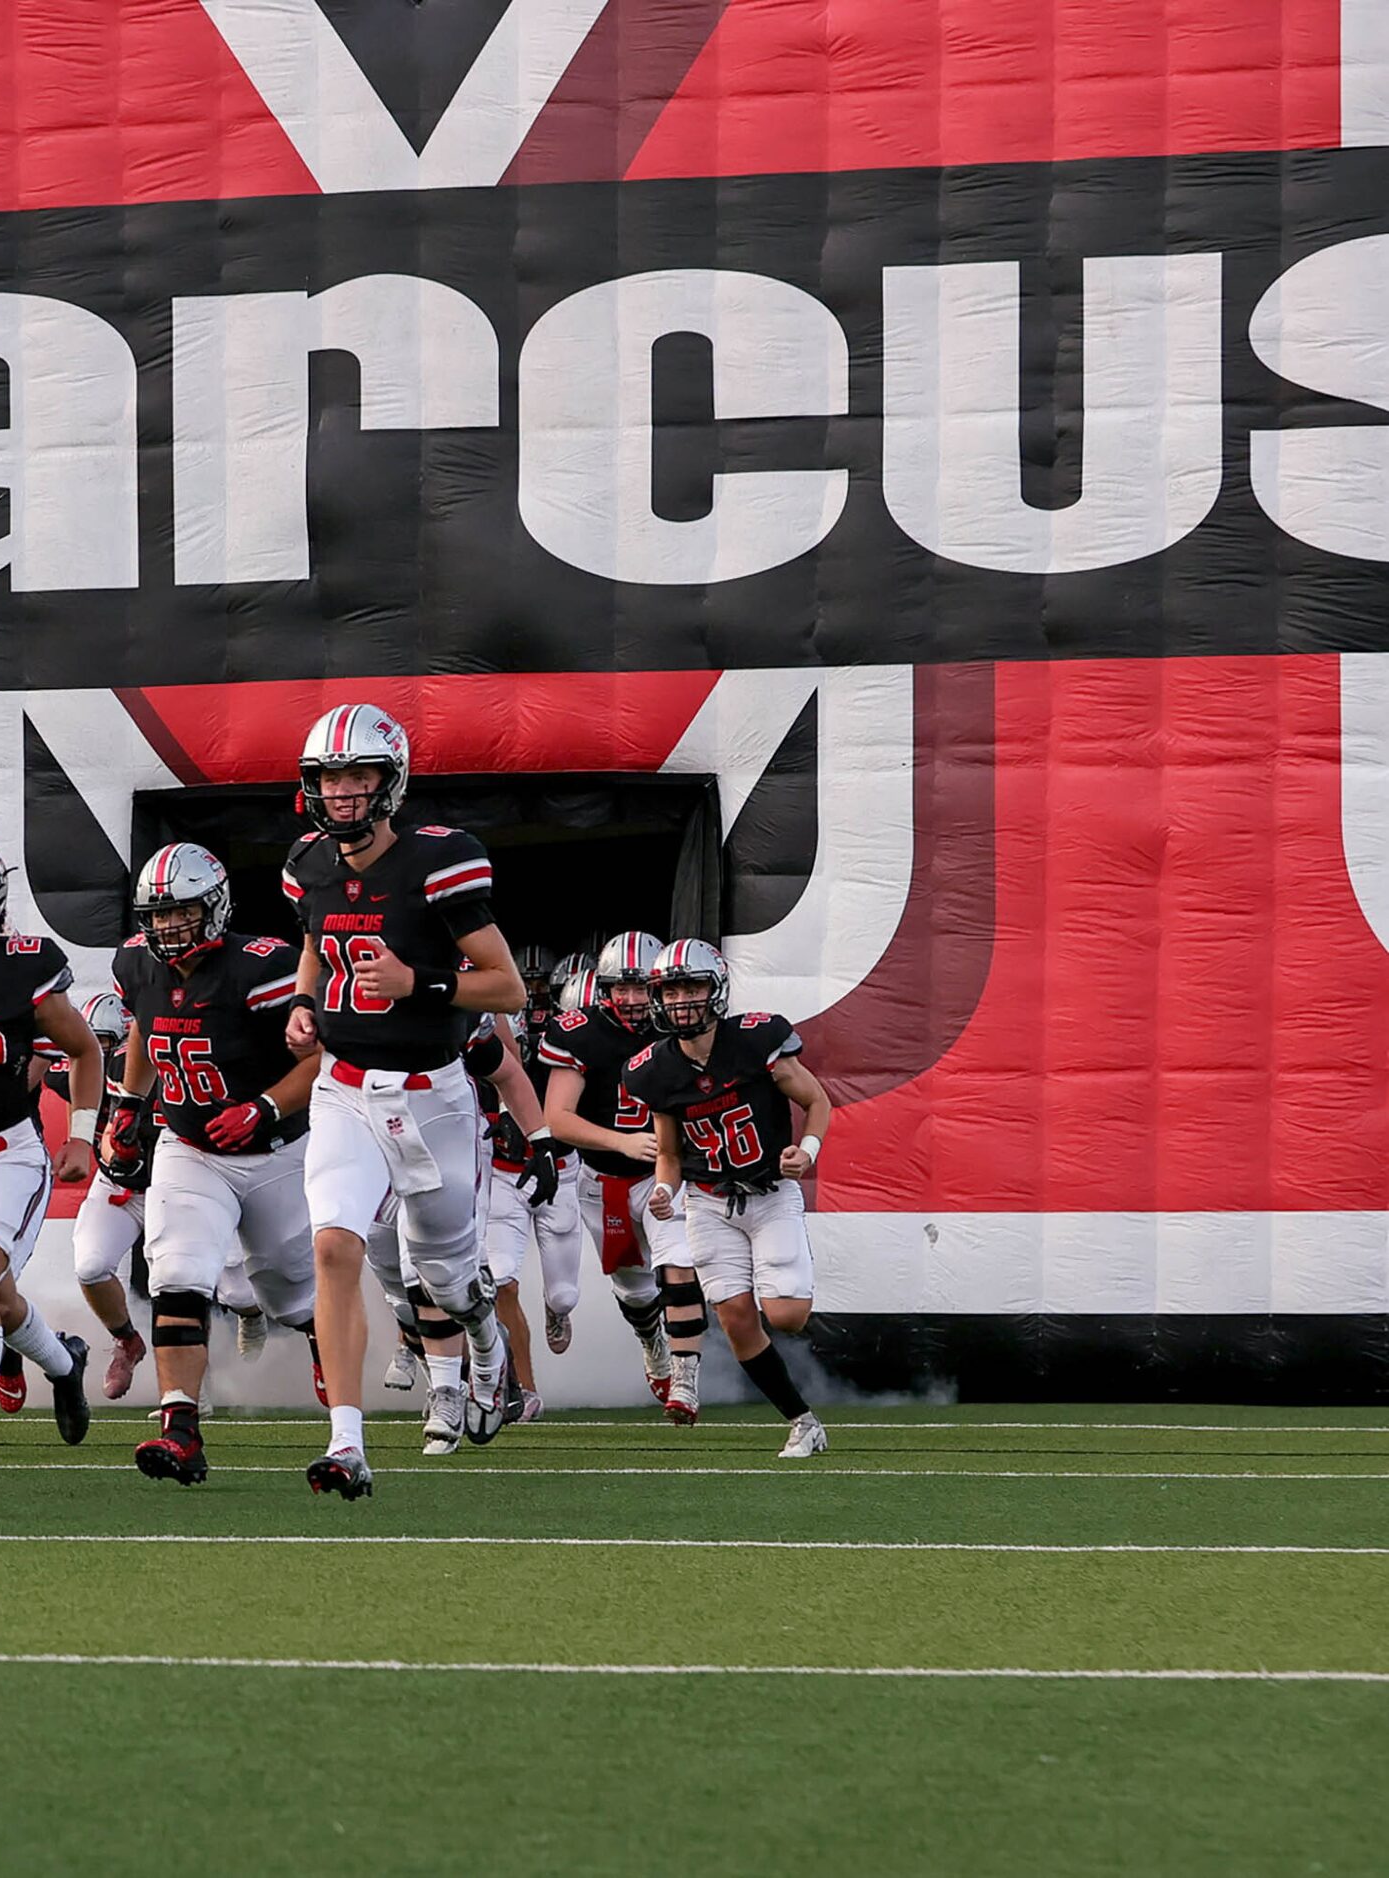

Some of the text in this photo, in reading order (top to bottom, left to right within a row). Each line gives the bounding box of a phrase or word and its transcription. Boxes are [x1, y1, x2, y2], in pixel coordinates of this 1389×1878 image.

[323, 913, 385, 932] MARCUS
[153, 1017, 202, 1034] MARCUS
[683, 1103, 764, 1172] 46
